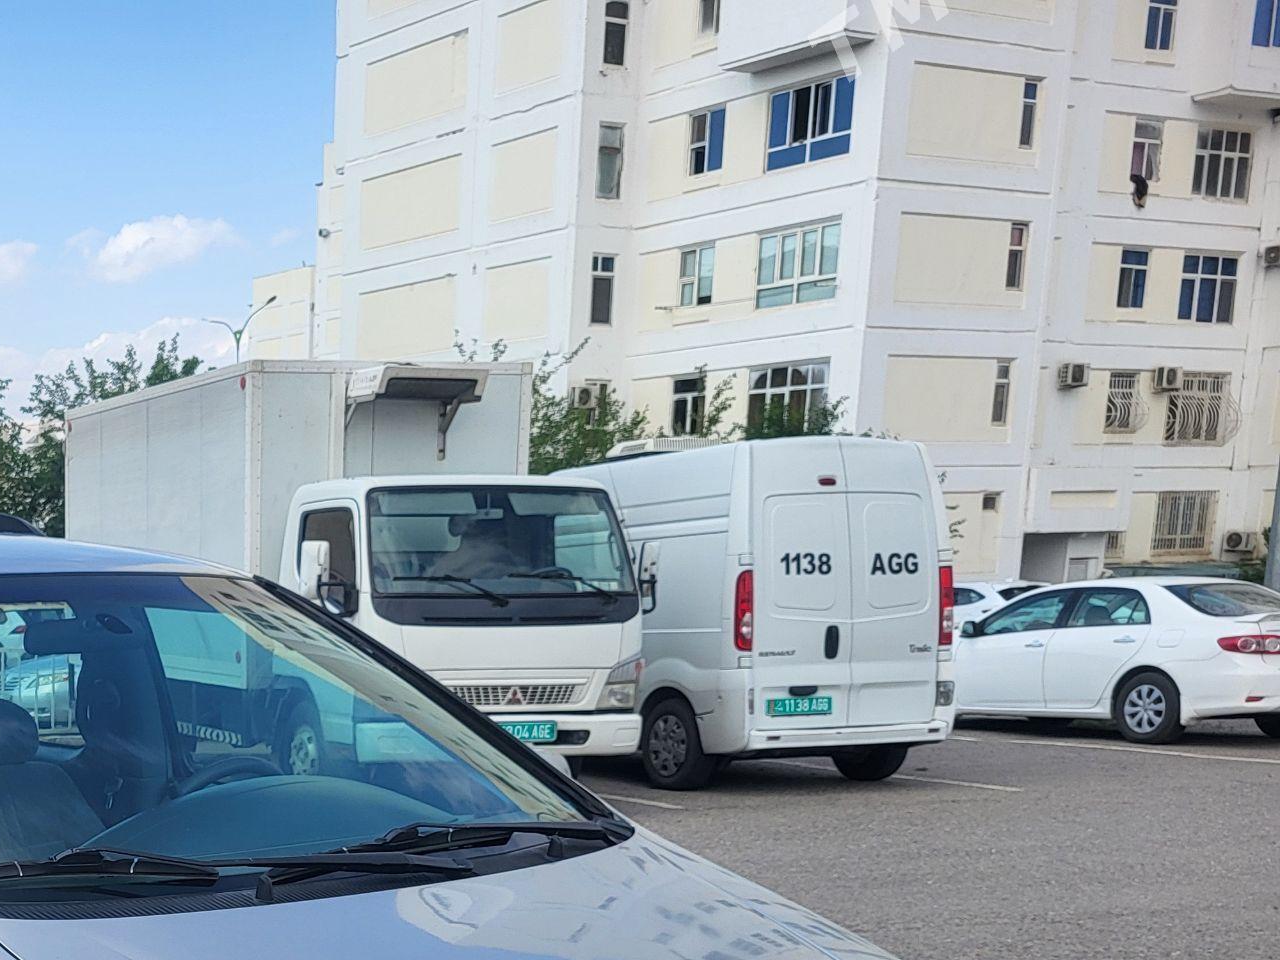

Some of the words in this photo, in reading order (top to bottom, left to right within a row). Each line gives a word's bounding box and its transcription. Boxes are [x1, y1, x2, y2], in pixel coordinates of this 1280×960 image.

[780, 552, 832, 575] 1138
[870, 552, 919, 575] AGG
[784, 699, 810, 712] 1138
[531, 724, 552, 738] AGE
